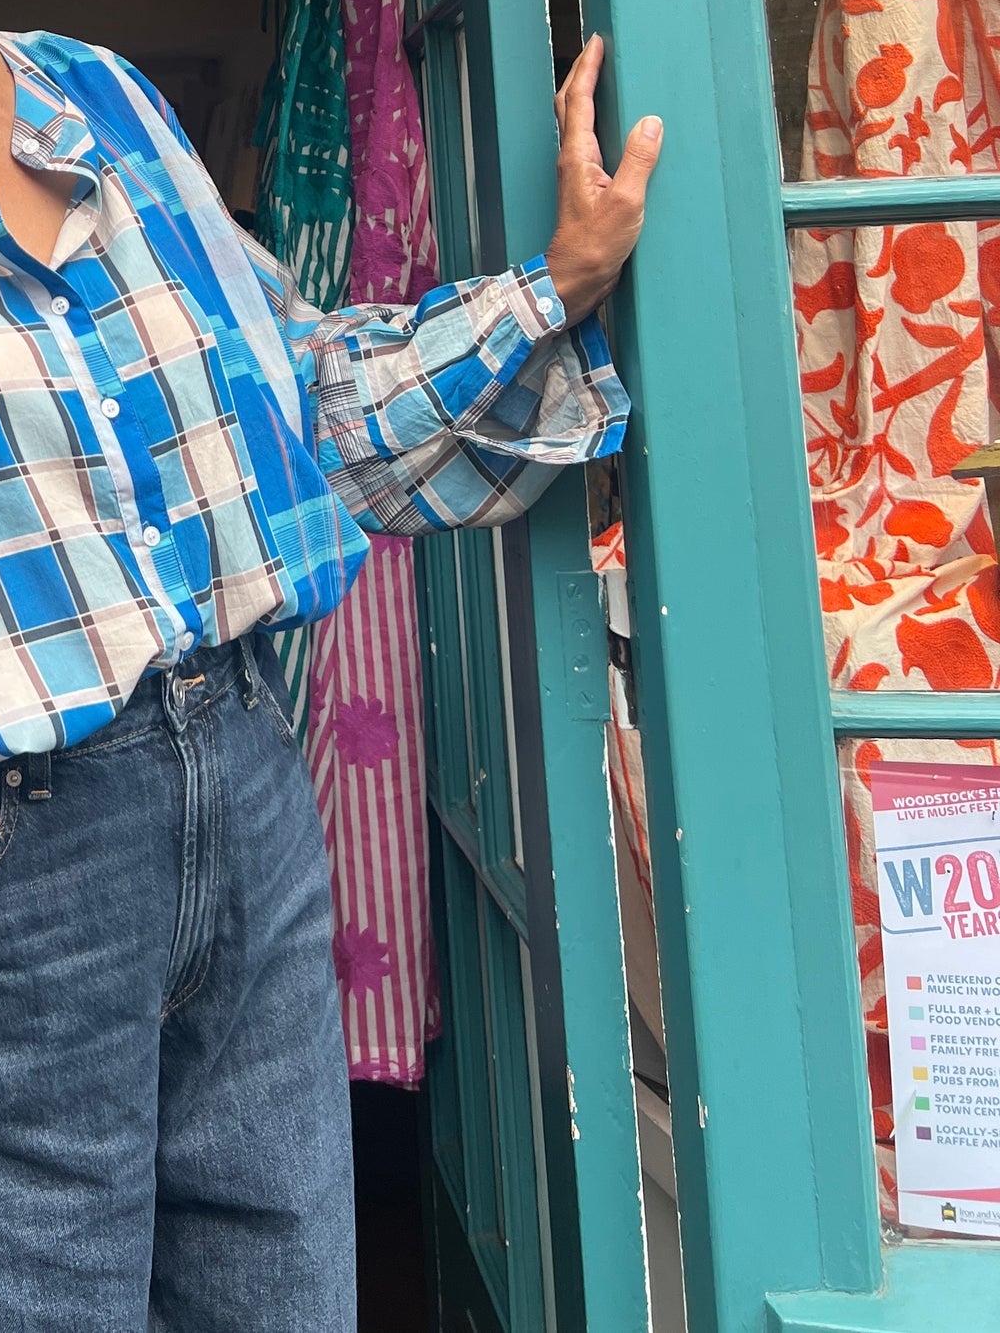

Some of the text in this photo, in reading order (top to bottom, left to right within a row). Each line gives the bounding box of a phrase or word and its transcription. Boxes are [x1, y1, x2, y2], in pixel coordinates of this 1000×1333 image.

[893, 788, 987, 808] WOODSTOCK'S
[897, 801, 998, 821] LIVE MUSIC FEST
[942, 911, 1000, 939] YEAR
[927, 974, 935, 983] A
[936, 974, 992, 985] WEEKEND
[927, 984, 1000, 996] MUSIC IN WO
[928, 1004, 956, 1014] FULL
[958, 1005, 981, 1015] BAR
[929, 1015, 962, 1025] FOOD
[930, 1034, 997, 1046] FREE ENTRY
[931, 1045, 999, 1057] FAMILY FRIE
[932, 1064, 997, 1077] FRI 28 AUG:
[933, 1075, 999, 1088] PUBS FROM
[934, 1093, 1000, 1106] SAT 29 AND
[935, 1104, 971, 1115] TOWN
[936, 1135, 1000, 1148] RAFFLE AN
